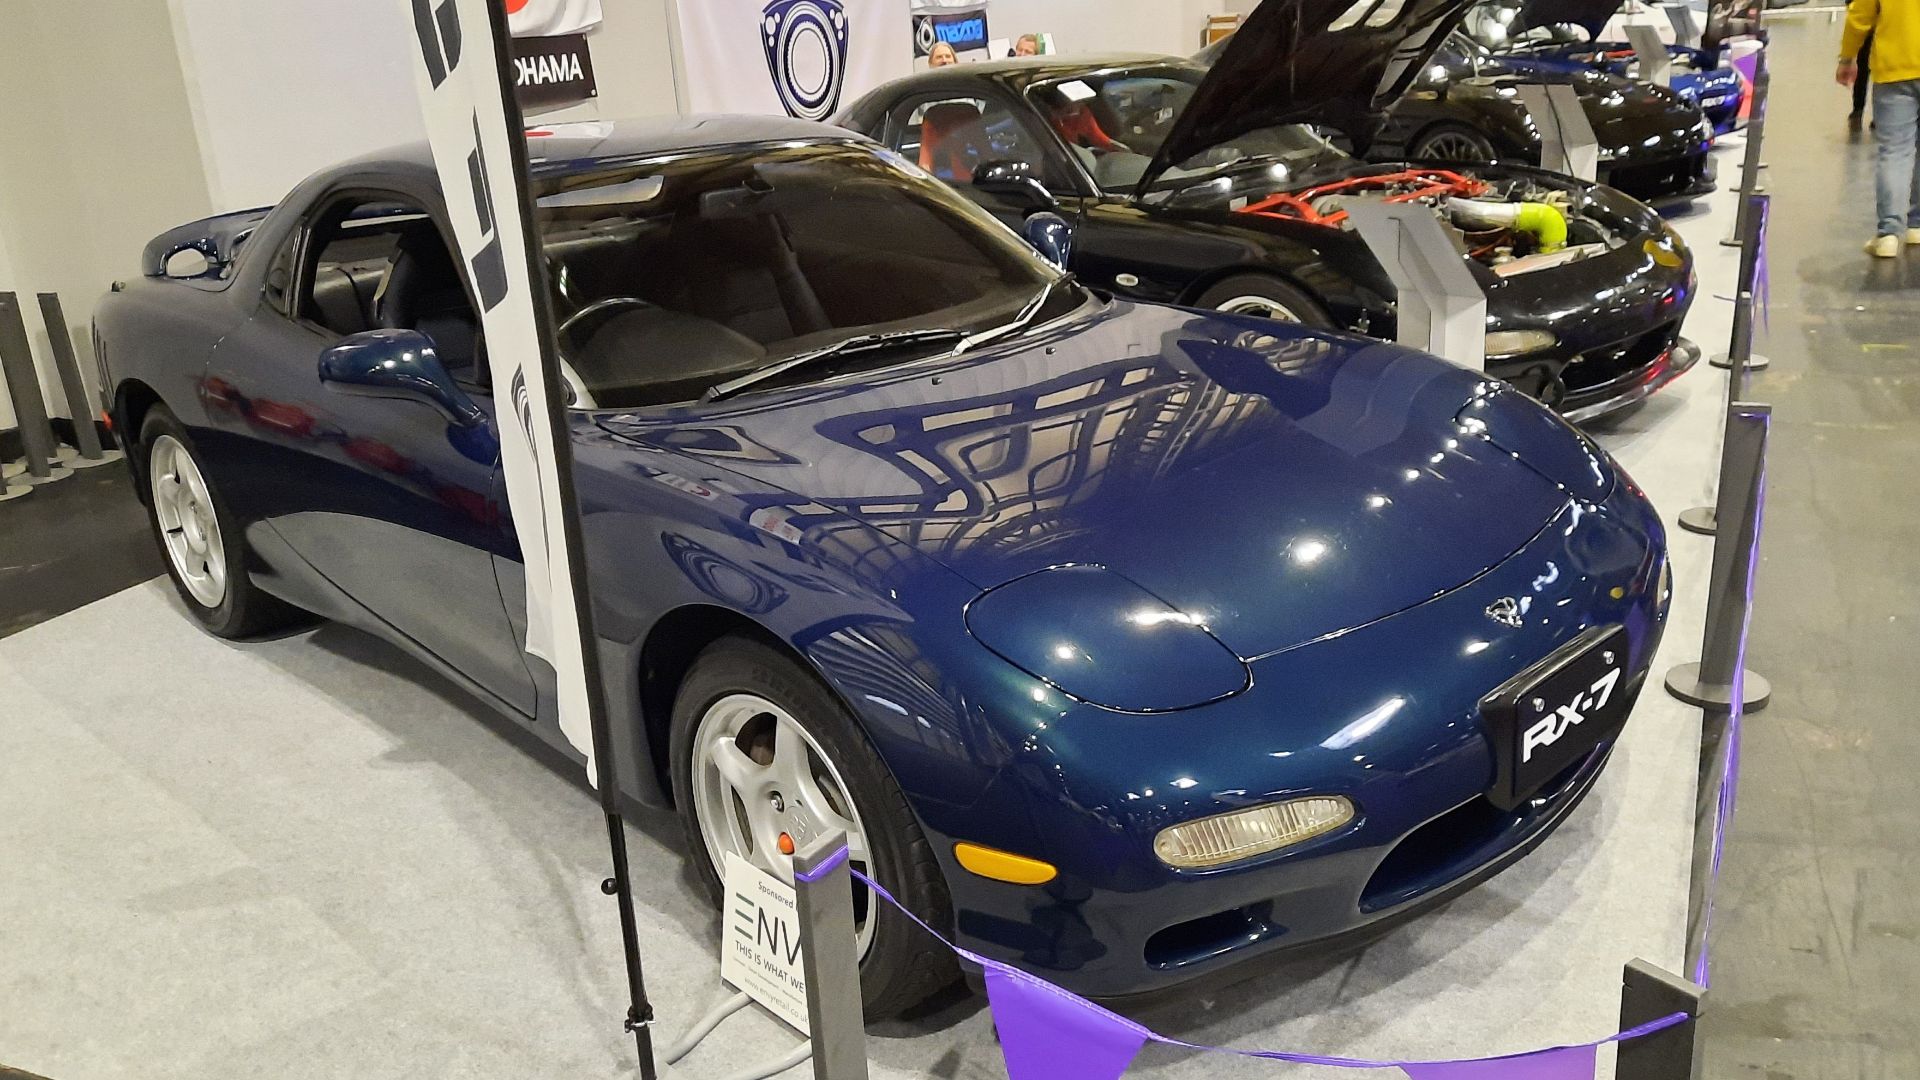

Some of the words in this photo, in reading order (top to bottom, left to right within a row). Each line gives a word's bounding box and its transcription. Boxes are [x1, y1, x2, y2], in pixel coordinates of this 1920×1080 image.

[1523, 667, 1621, 763] RX-7
[758, 881, 794, 909] Sponsored
[735, 940, 752, 960] THIS
[754, 953, 761, 966] IS
[763, 958, 788, 983] WHAT
[790, 976, 804, 994] WE
